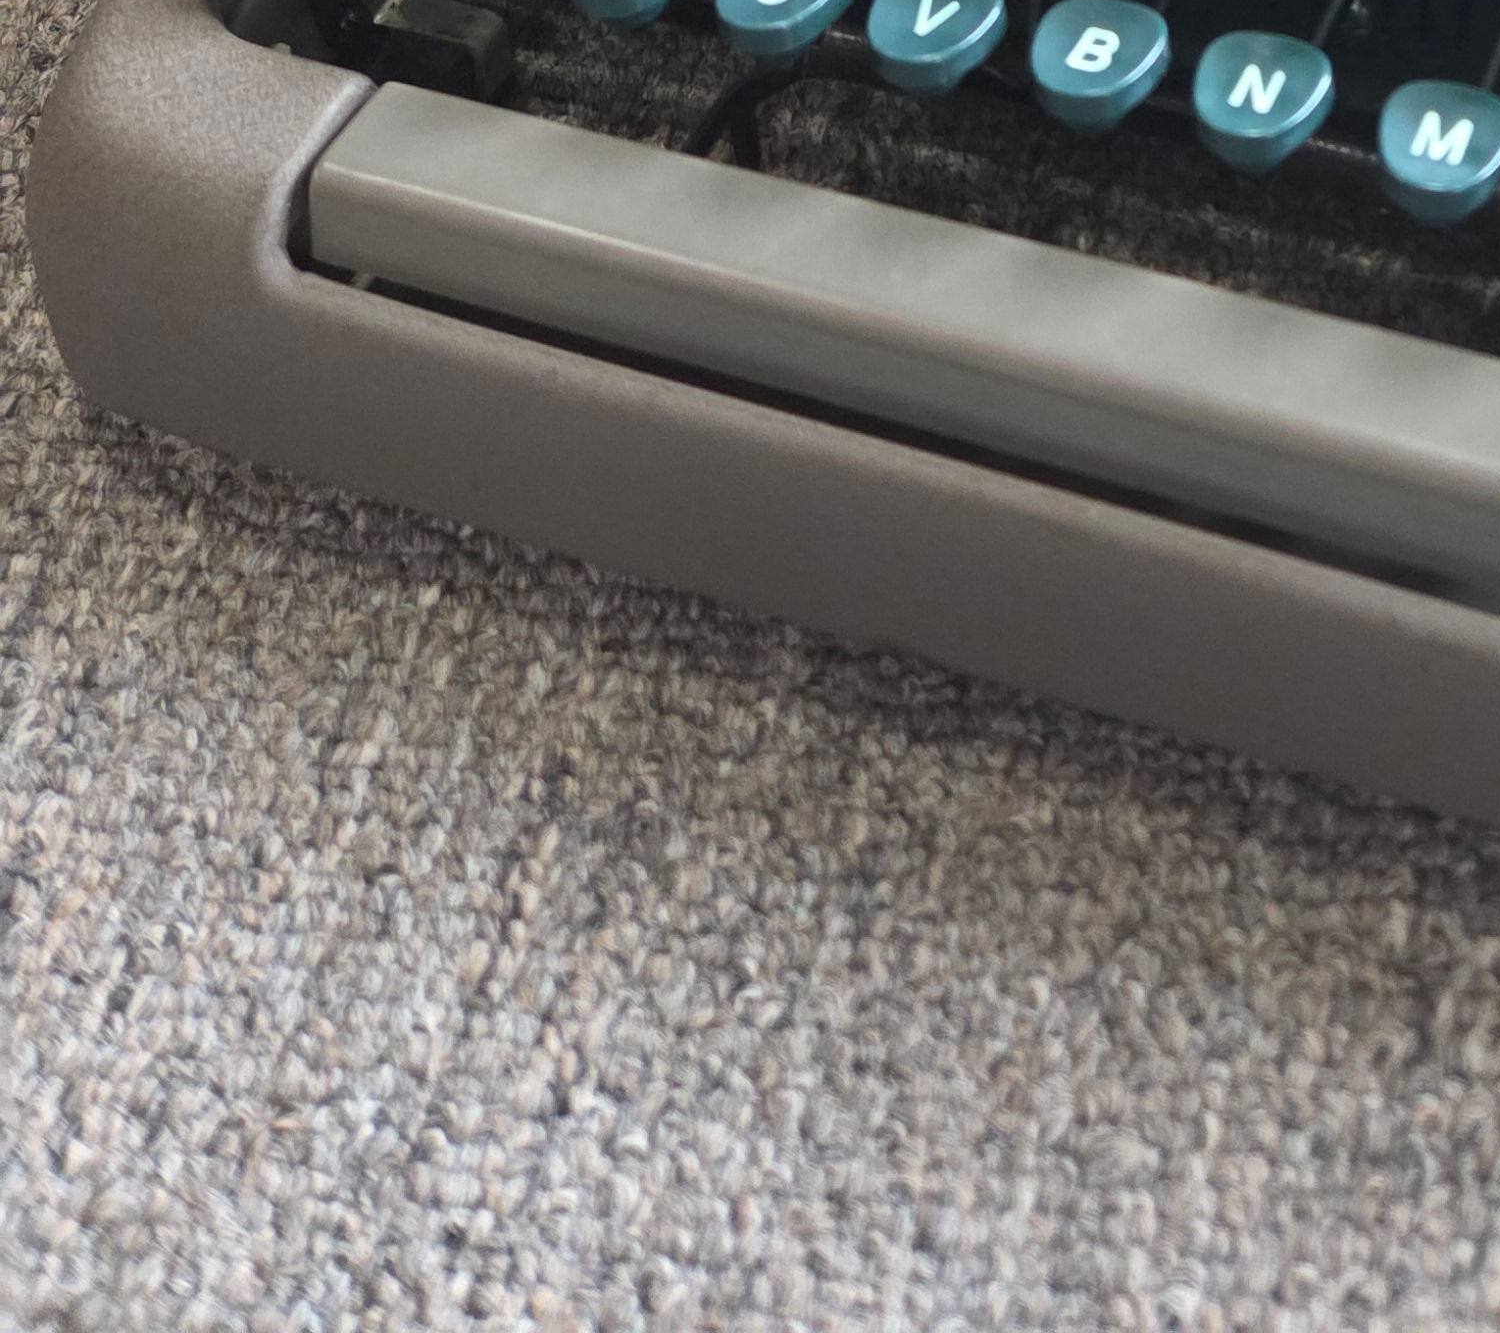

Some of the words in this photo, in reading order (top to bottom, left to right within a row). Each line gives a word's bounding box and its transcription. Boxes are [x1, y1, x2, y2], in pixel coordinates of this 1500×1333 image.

[1064, 26, 1120, 73] B
[1227, 63, 1287, 114] N
[1409, 110, 1474, 166] M
